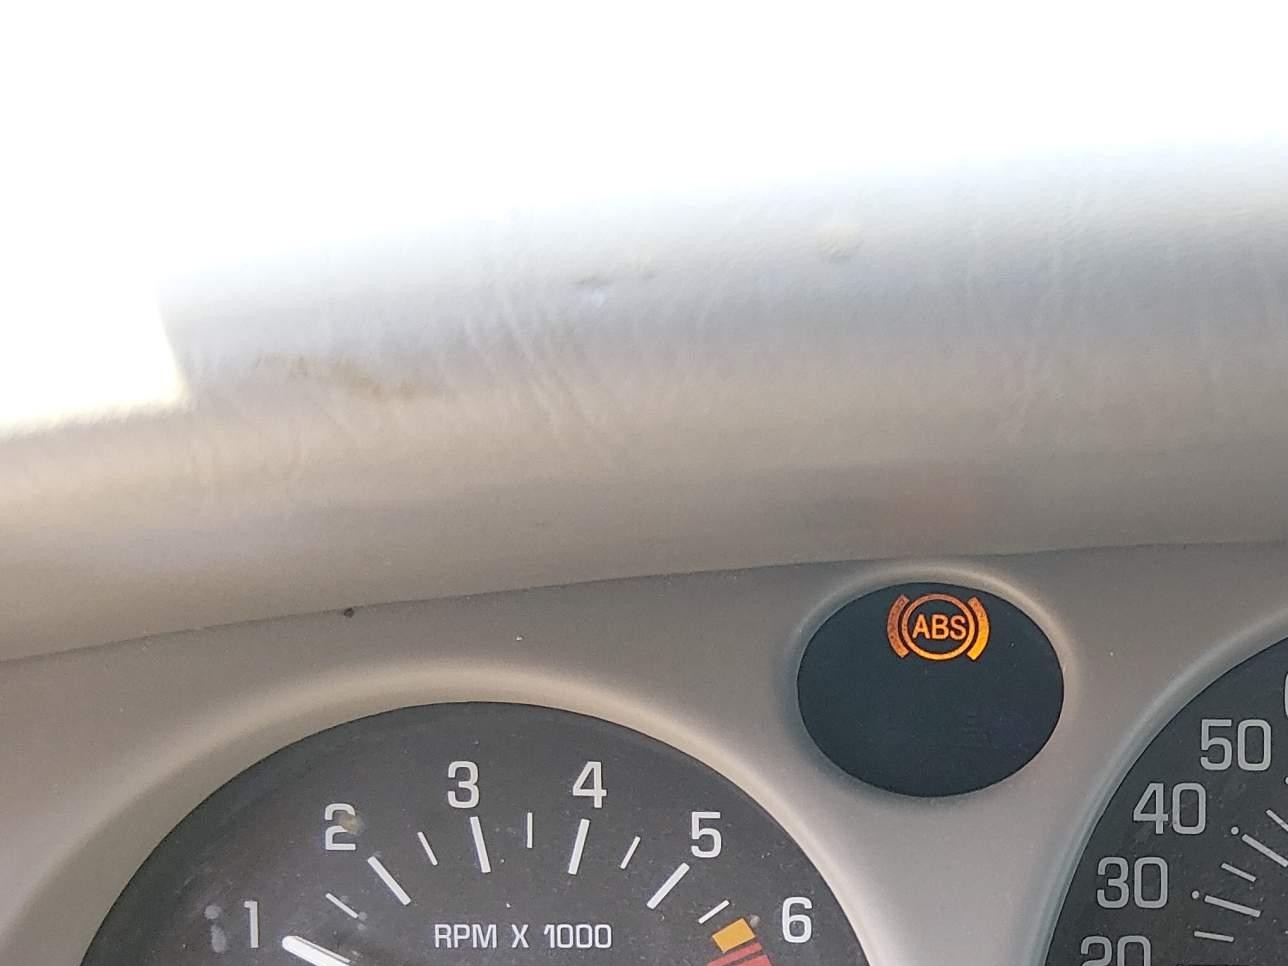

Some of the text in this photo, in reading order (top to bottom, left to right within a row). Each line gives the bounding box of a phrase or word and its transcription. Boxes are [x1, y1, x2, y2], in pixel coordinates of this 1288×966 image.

[911, 613, 967, 640] ABS
[1200, 719, 1271, 772] 50
[447, 761, 481, 810] 3
[571, 761, 608, 809] 4
[1133, 783, 1207, 835] 40
[324, 803, 358, 852] 2
[690, 811, 722, 859] 5
[1096, 857, 1168, 909] 30
[243, 901, 260, 950] 1
[433, 923, 613, 951] RPM X 1000
[780, 897, 813, 944] 6
